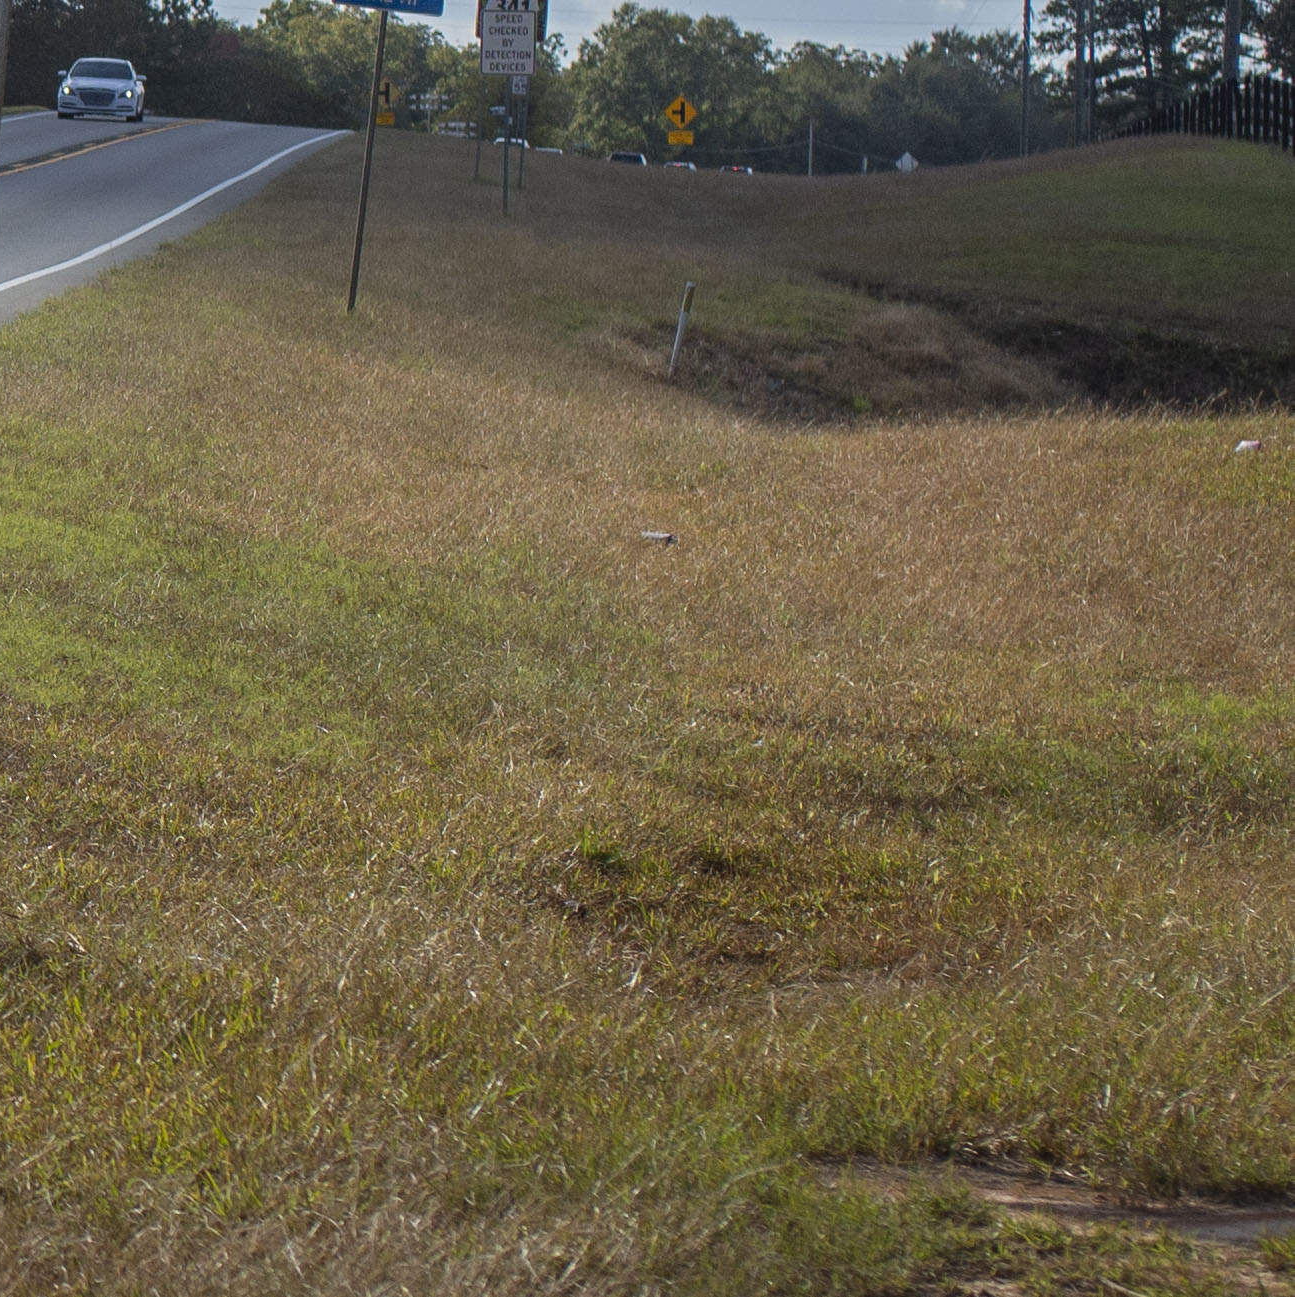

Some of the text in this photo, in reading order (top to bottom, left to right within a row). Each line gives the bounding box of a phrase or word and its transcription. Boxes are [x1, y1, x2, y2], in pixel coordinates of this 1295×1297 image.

[495, 14, 523, 23] SPEED
[489, 26, 528, 36] CHECKED
[502, 38, 514, 47] BY
[485, 50, 531, 59] DETECTION
[489, 63, 526, 72] DEVICES
